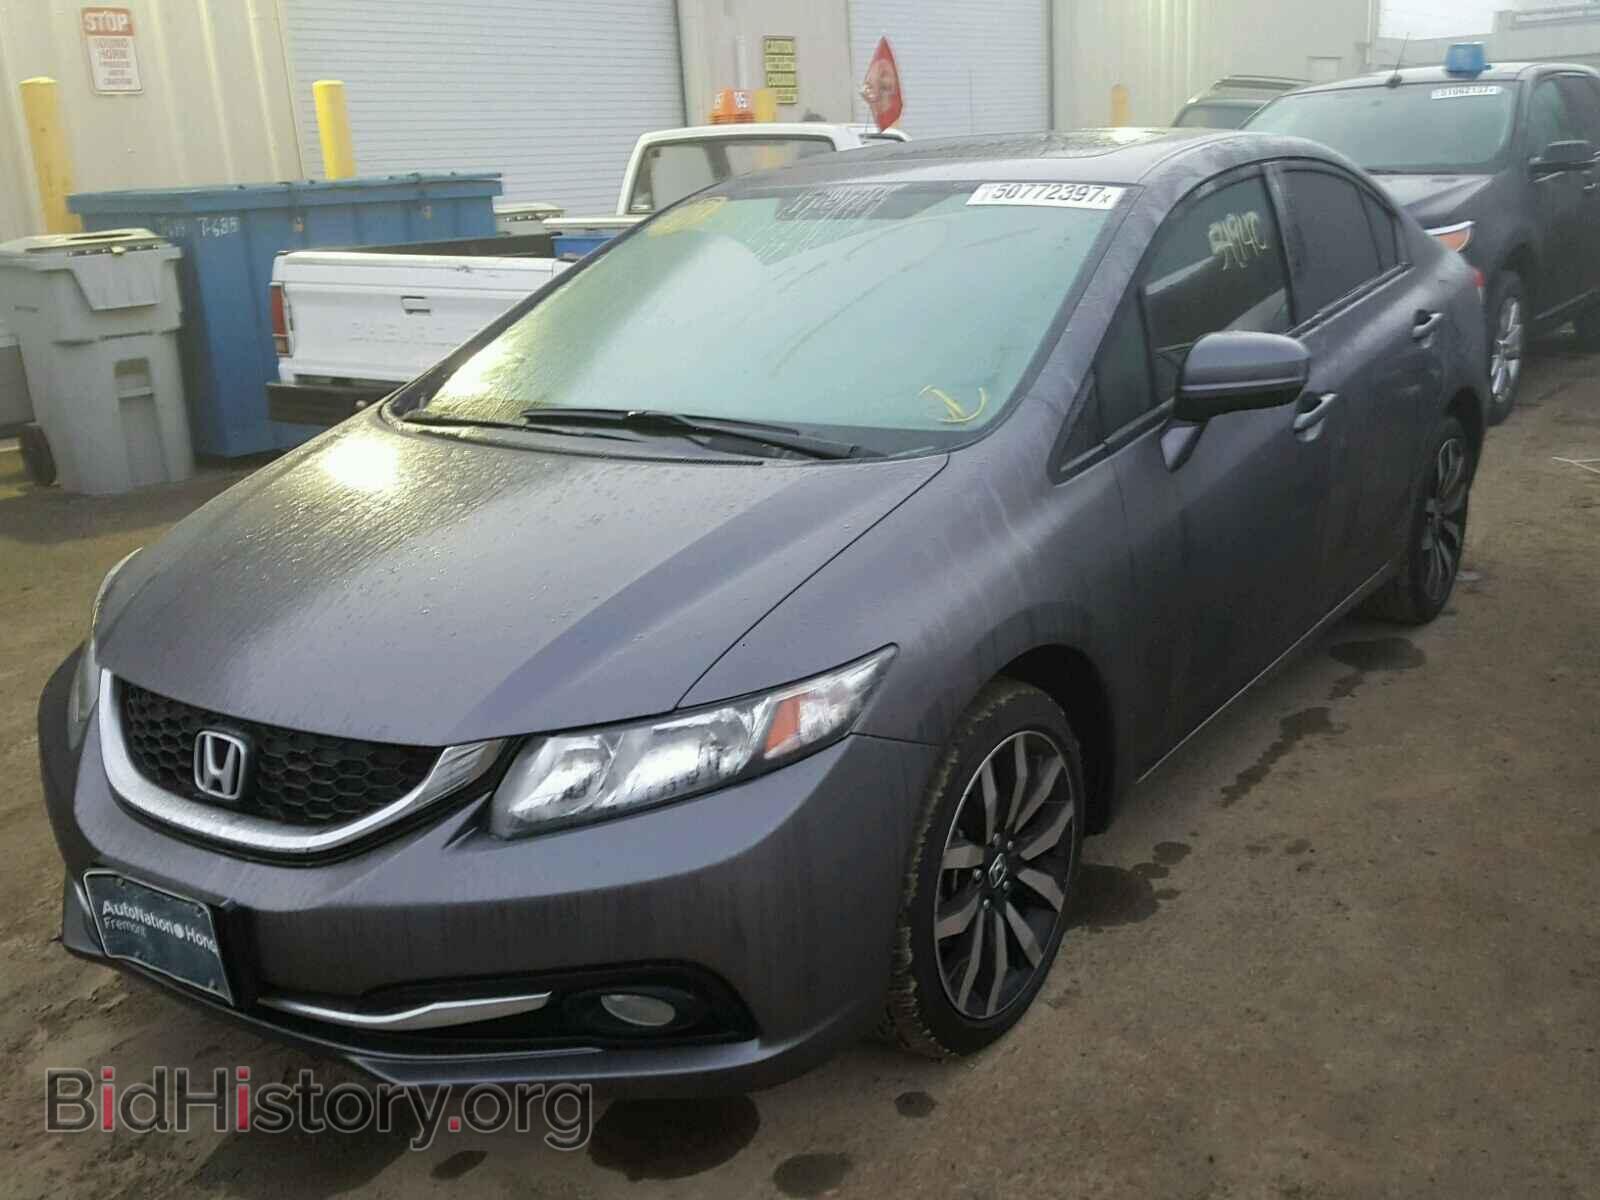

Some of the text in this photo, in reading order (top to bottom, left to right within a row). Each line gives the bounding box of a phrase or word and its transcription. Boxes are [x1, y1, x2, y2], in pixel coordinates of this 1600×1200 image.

[83, 11, 129, 32] STOP
[992, 183, 1105, 203] 50772397
[102, 900, 174, 936] AutoNation
